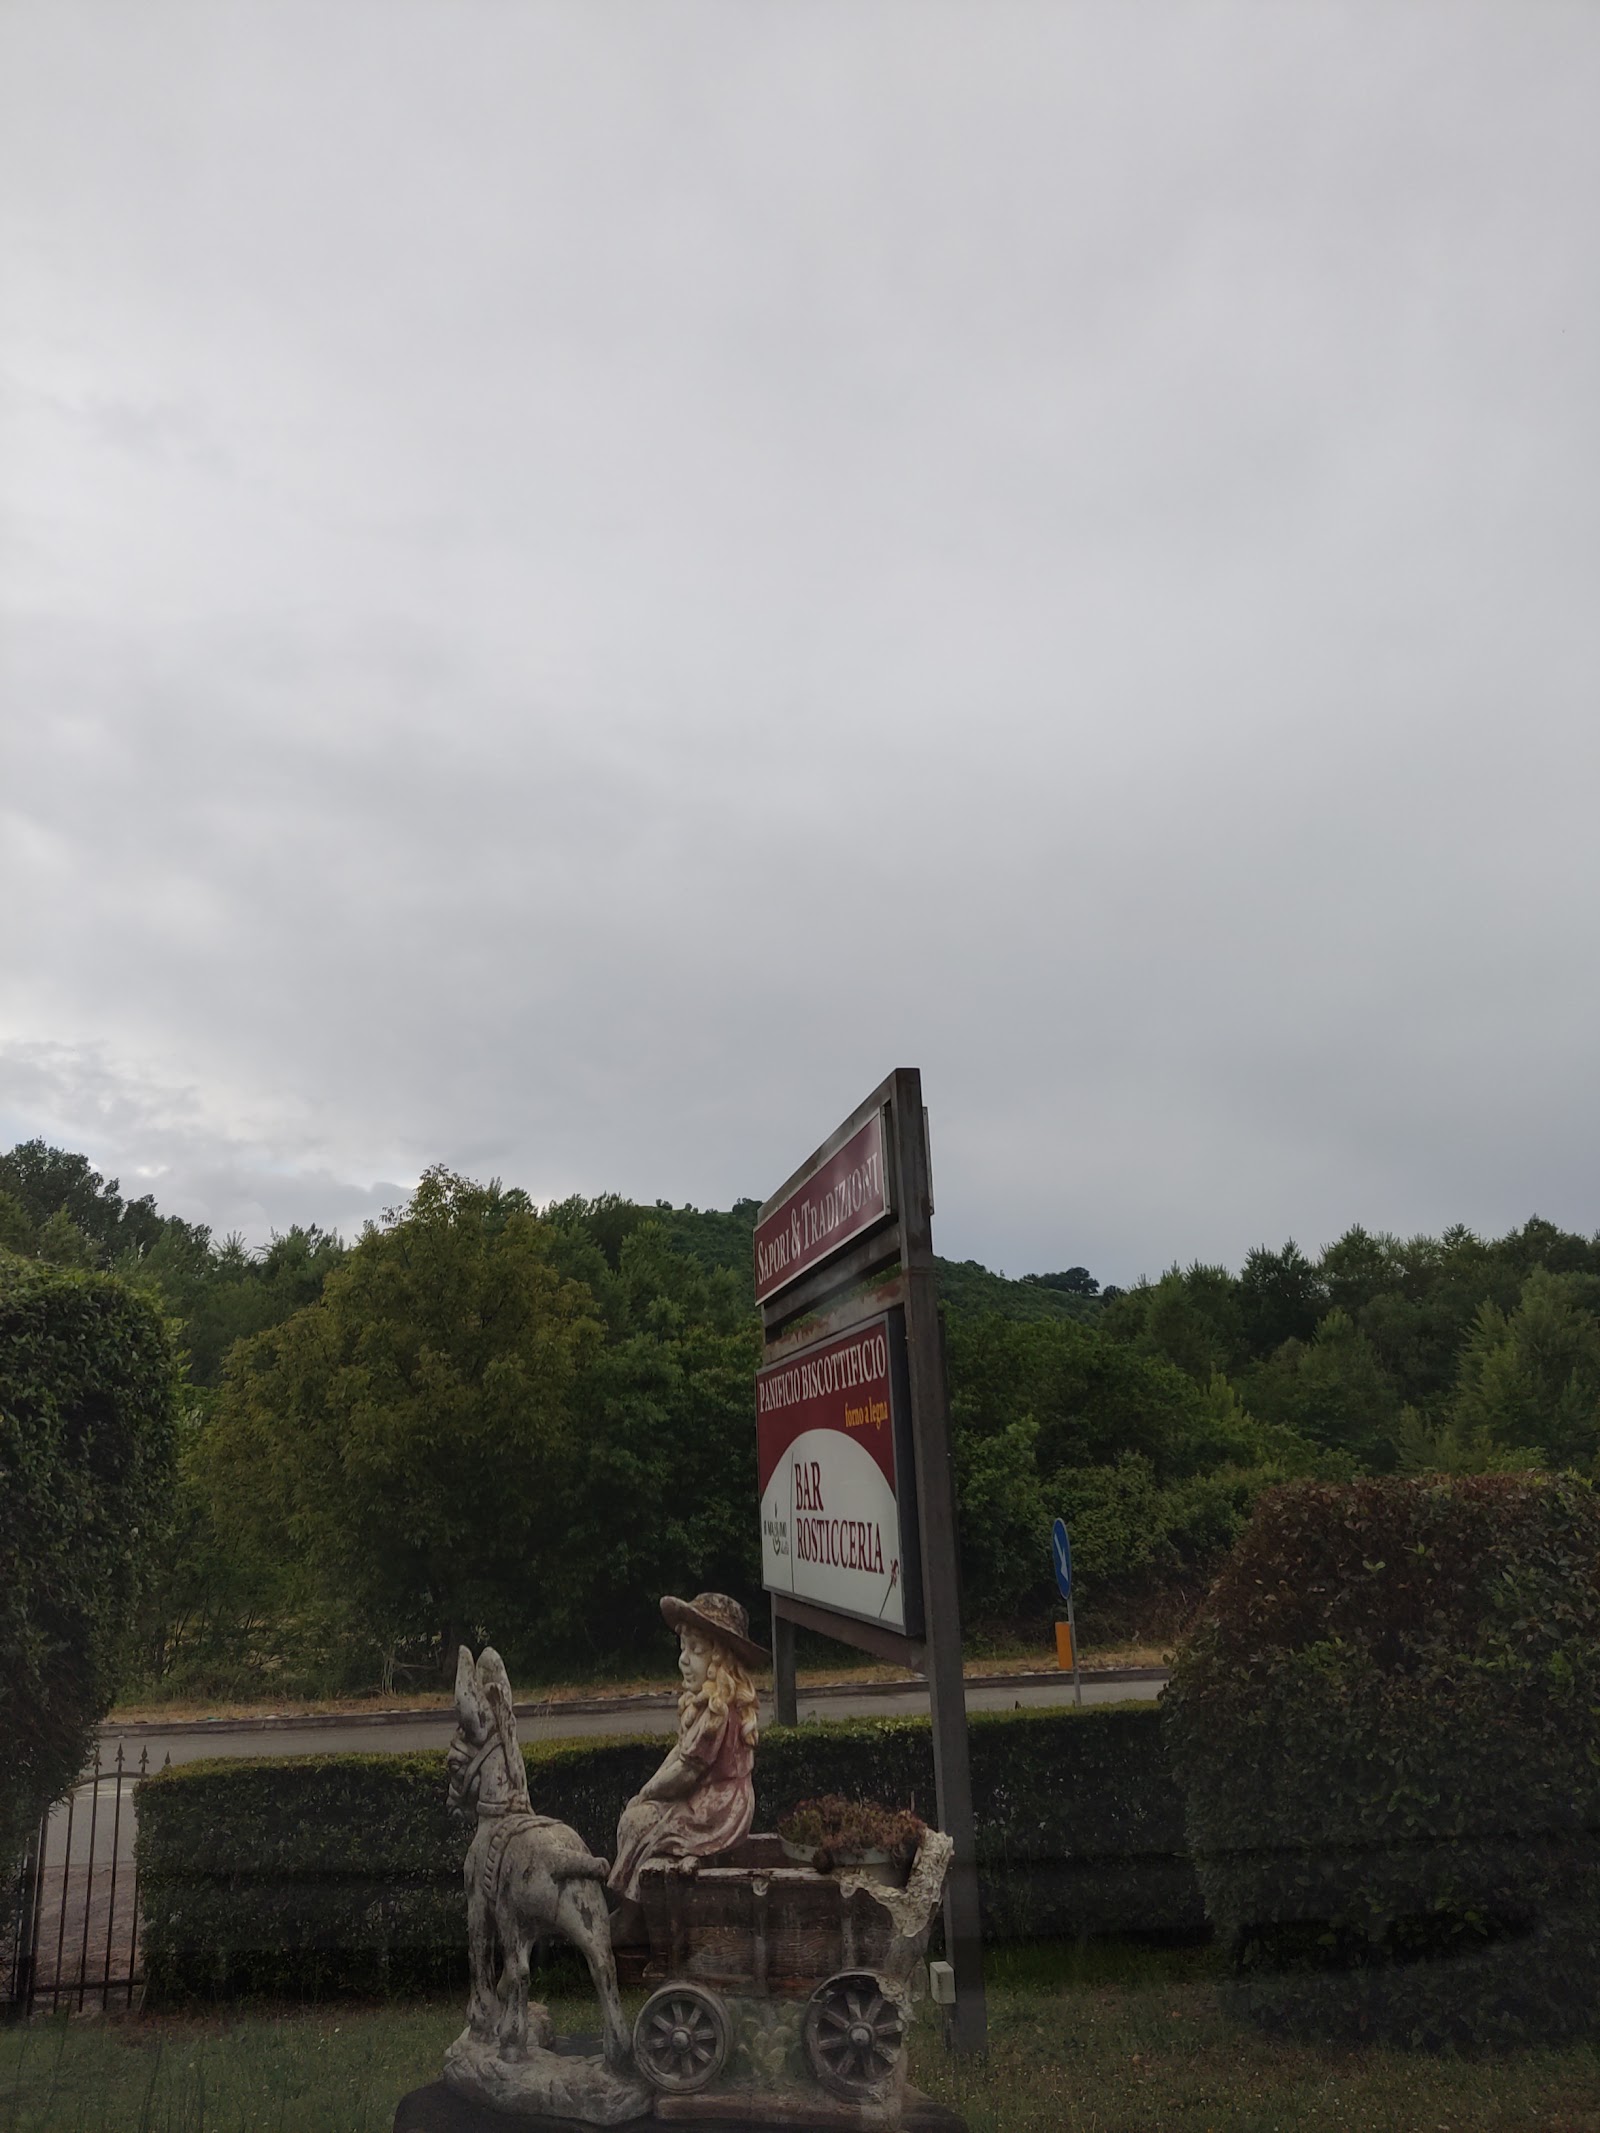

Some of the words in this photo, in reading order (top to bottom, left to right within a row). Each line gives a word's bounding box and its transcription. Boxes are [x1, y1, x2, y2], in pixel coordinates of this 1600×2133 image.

[791, 1207, 801, 1260] &
[801, 1152, 879, 1251] TRADIZIONI
[759, 1368, 801, 1413] PANIFICIO
[801, 1334, 886, 1401] BISCOTTIFICIO
[845, 1402, 864, 1427] forno
[869, 1396, 888, 1430] legna
[794, 1461, 824, 1512] BAR
[796, 1517, 885, 1574] ROSTICCERIA
